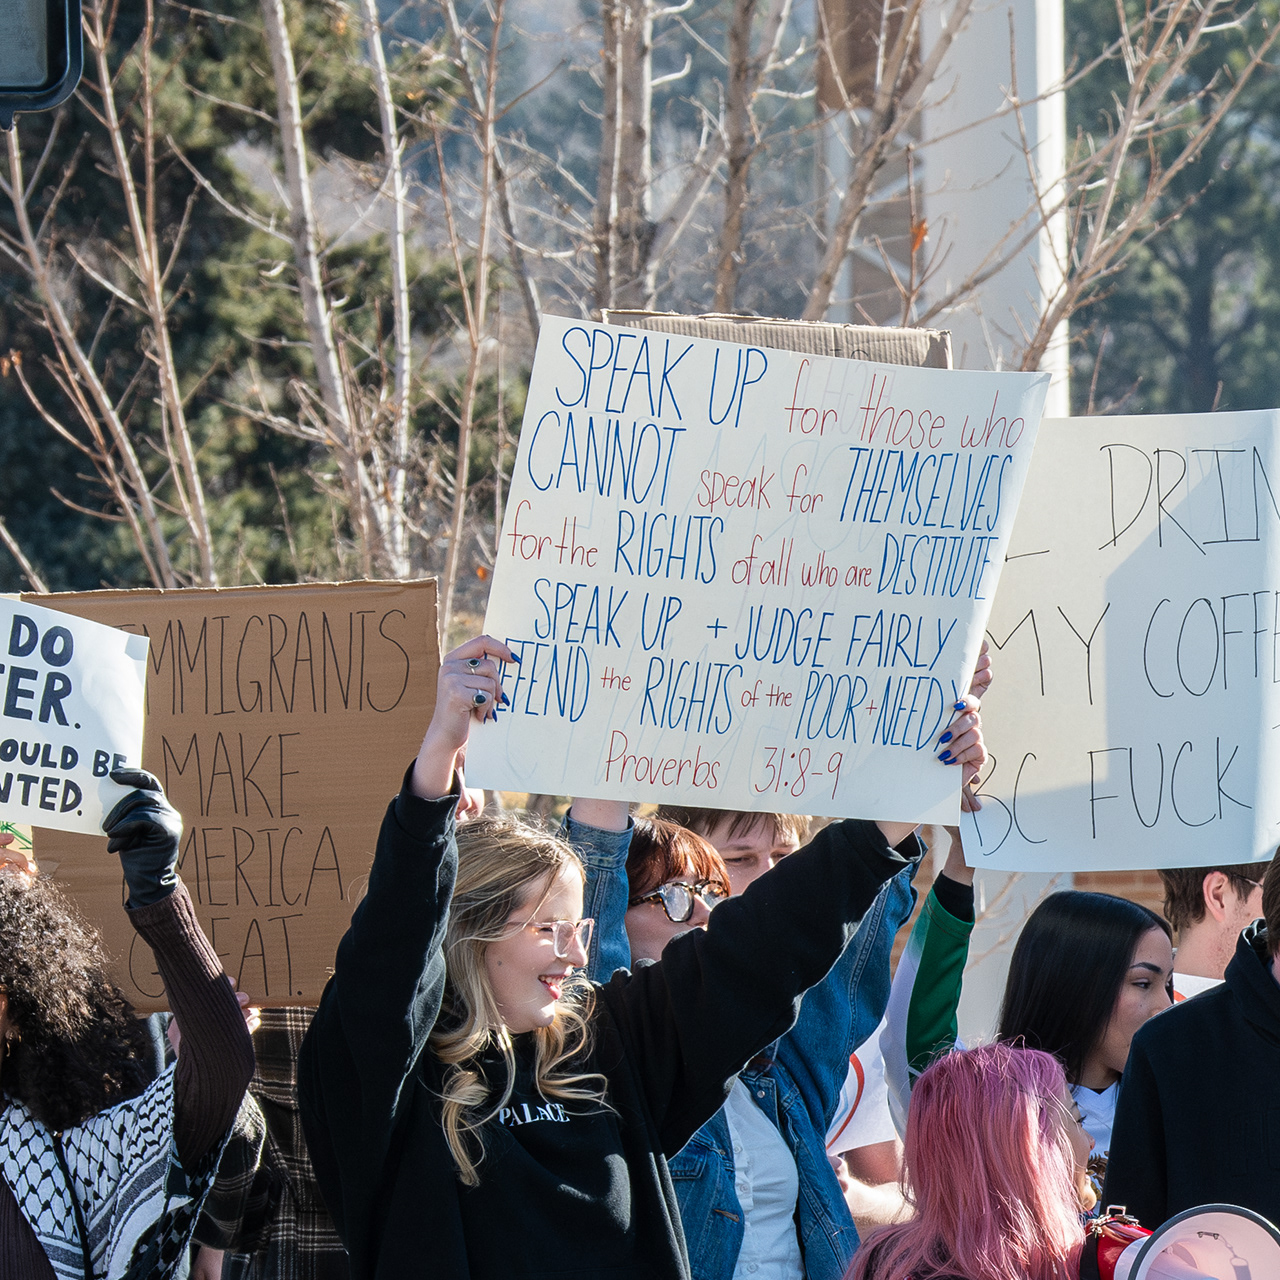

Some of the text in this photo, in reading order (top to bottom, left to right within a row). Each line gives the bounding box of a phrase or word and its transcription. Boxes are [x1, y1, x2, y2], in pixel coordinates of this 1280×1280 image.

[555, 327, 1025, 450] SPEAK UP for those who
[528, 411, 1013, 531] CANNOT speak for THEMSELVES
[507, 500, 999, 600] for the RIGHTS of all who are DESTITUTE
[8, 614, 74, 667] DO
[112, 610, 410, 716] MMIGRANTS
[533, 578, 629, 648] SPEAK
[641, 592, 682, 651] UP
[735, 605, 835, 668] JUDGE
[846, 608, 957, 671] FAIRLY
[985, 602, 1111, 705] MY
[0, 664, 81, 730] ER.
[486, 638, 590, 722] EFEND
[600, 666, 632, 691] the
[640, 656, 743, 734] RIGHTS
[741, 680, 762, 708] of
[766, 683, 792, 707] the
[162, 732, 301, 819] MAKE
[606, 730, 844, 800] Proverbs 31:8-9
[973, 752, 1048, 856] BC
[1087, 736, 1252, 839] FUCK
[129, 913, 303, 998] GEAT.
[500, 1103, 570, 1127] PALACE
